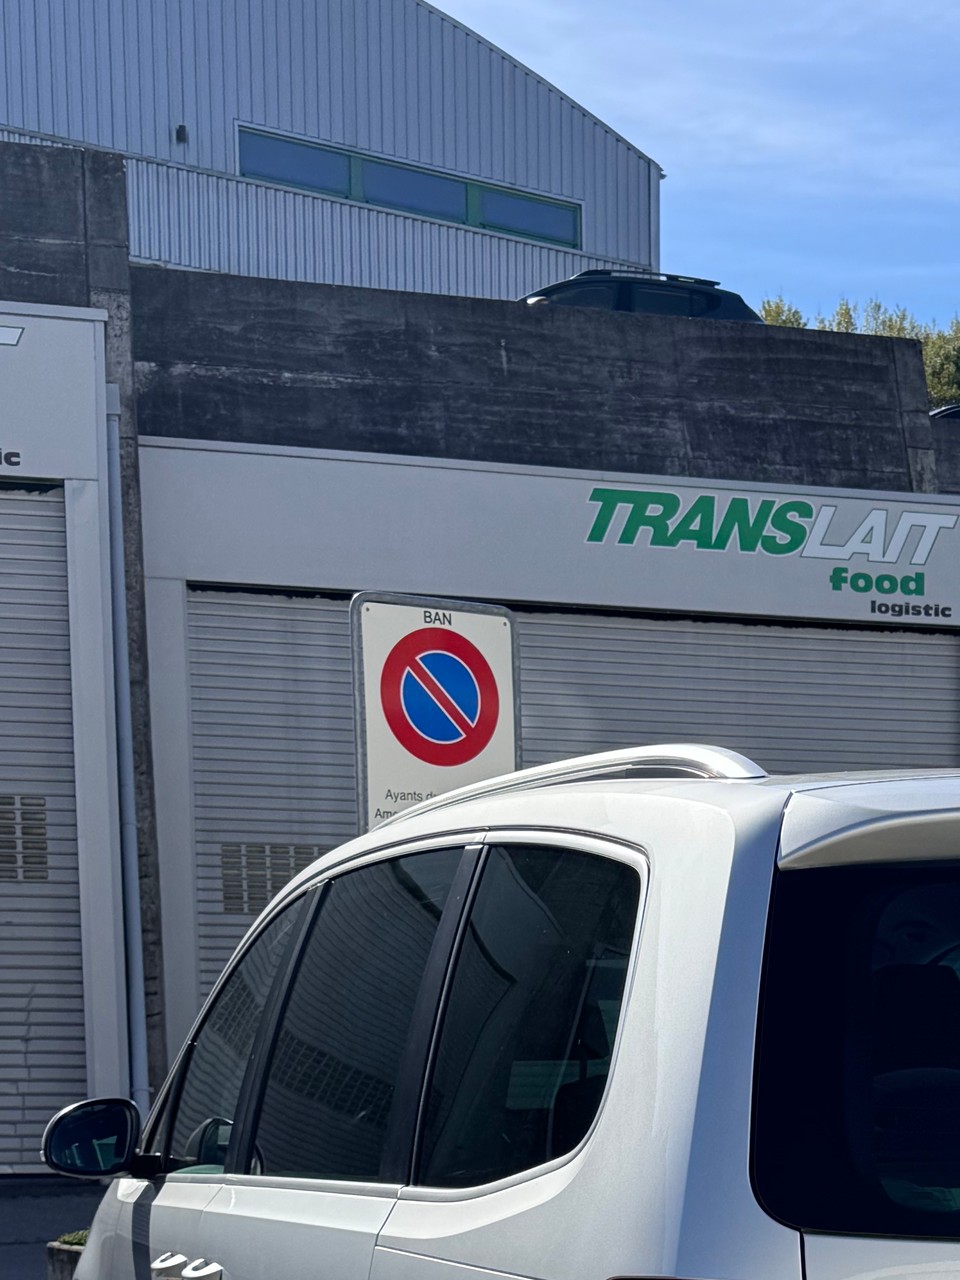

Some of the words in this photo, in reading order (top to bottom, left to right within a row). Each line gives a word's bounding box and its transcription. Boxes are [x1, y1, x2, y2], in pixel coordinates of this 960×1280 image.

[584, 487, 960, 566] TRANSLAIT
[829, 567, 925, 597] food
[423, 610, 452, 626] BAN
[870, 600, 953, 619] logistic
[385, 789, 423, 803] Ayants
